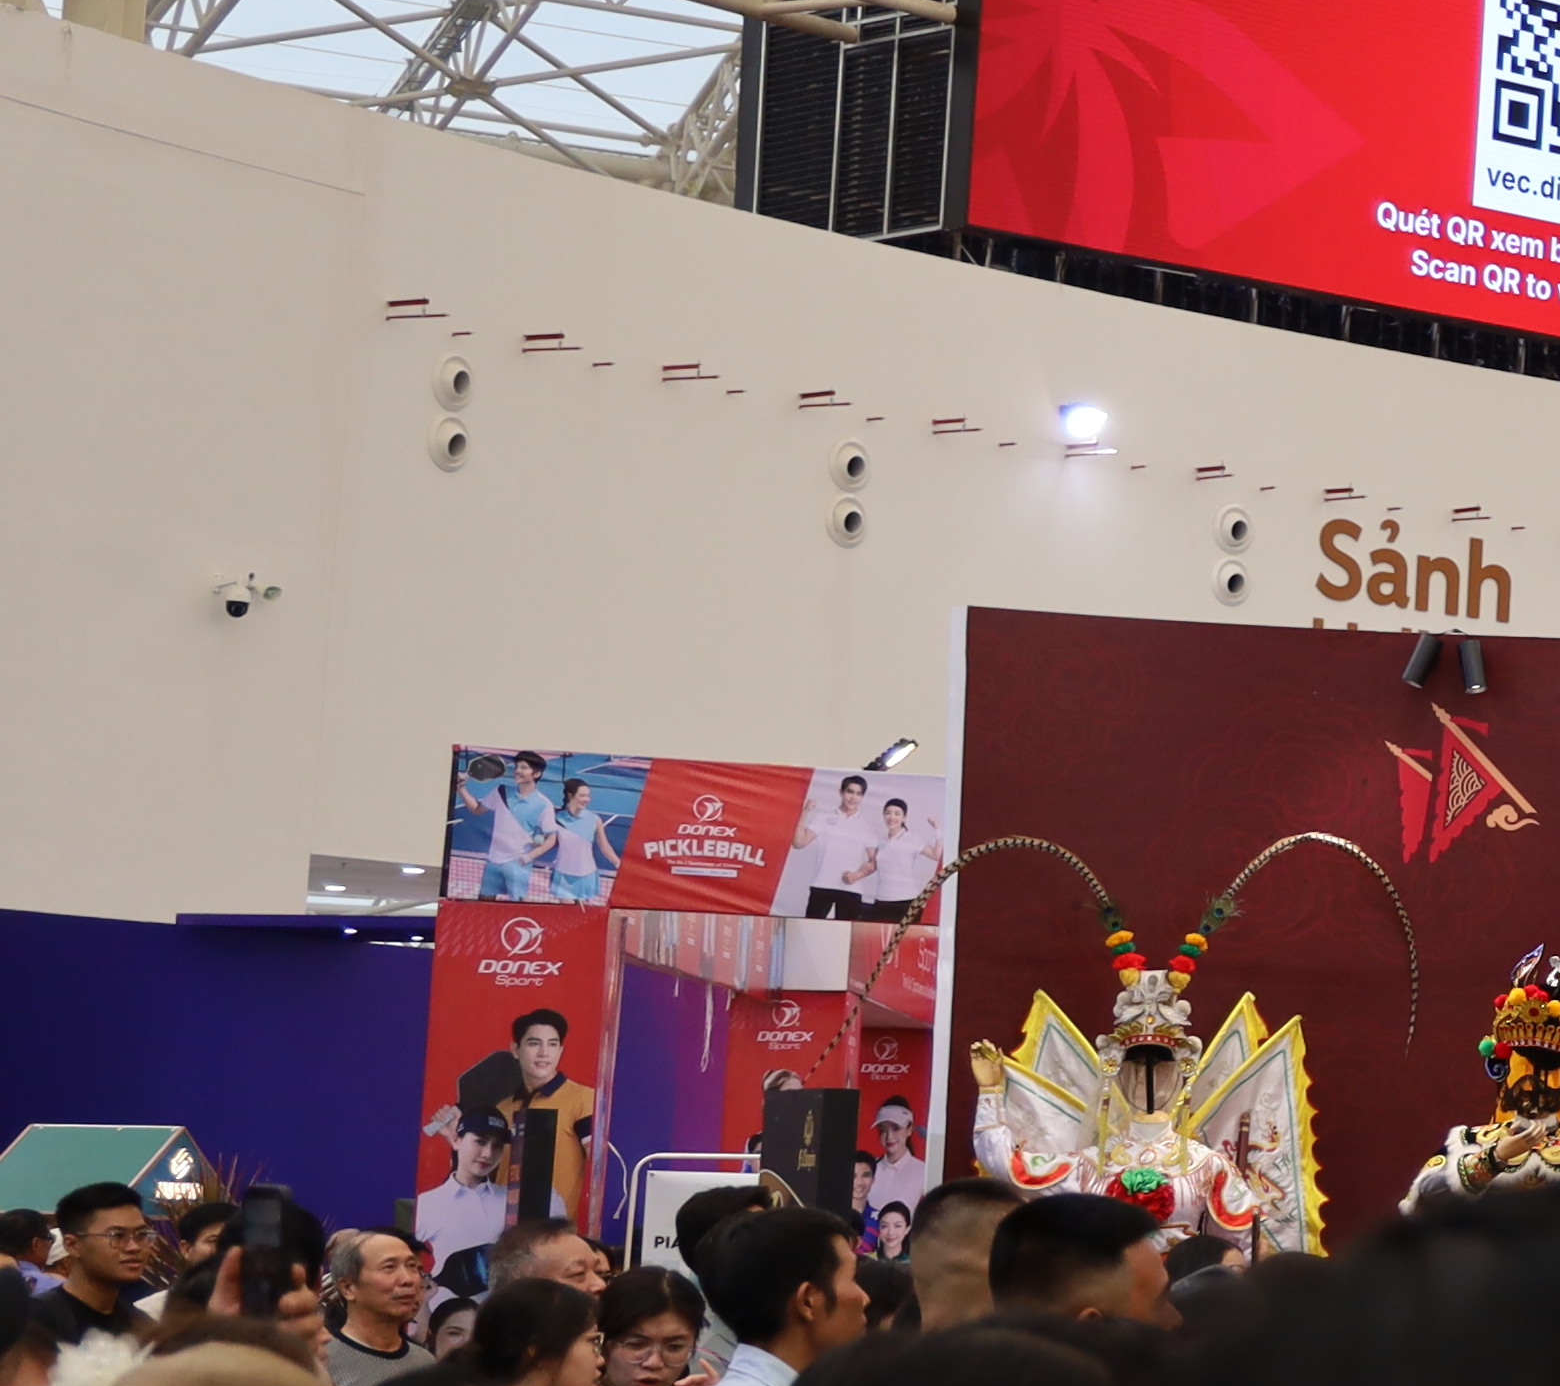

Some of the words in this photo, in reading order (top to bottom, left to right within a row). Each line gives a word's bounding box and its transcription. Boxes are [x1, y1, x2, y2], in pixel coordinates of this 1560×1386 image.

[1376, 201, 1441, 239] Quét
[1446, 216, 1486, 247] QR
[1490, 229, 1544, 259] xem
[1411, 249, 1477, 286] Scan
[1483, 263, 1521, 295] QR
[1525, 273, 1552, 300] to
[1315, 519, 1512, 623] Sảnh
[677, 823, 738, 837] DONEX
[643, 838, 765, 867] PICKLEBALL
[477, 959, 563, 975] DONEX
[495, 974, 544, 987] Sport
[757, 1031, 814, 1042] DONEX
[768, 1041, 801, 1050] Sport
[861, 1063, 910, 1074] DONEX
